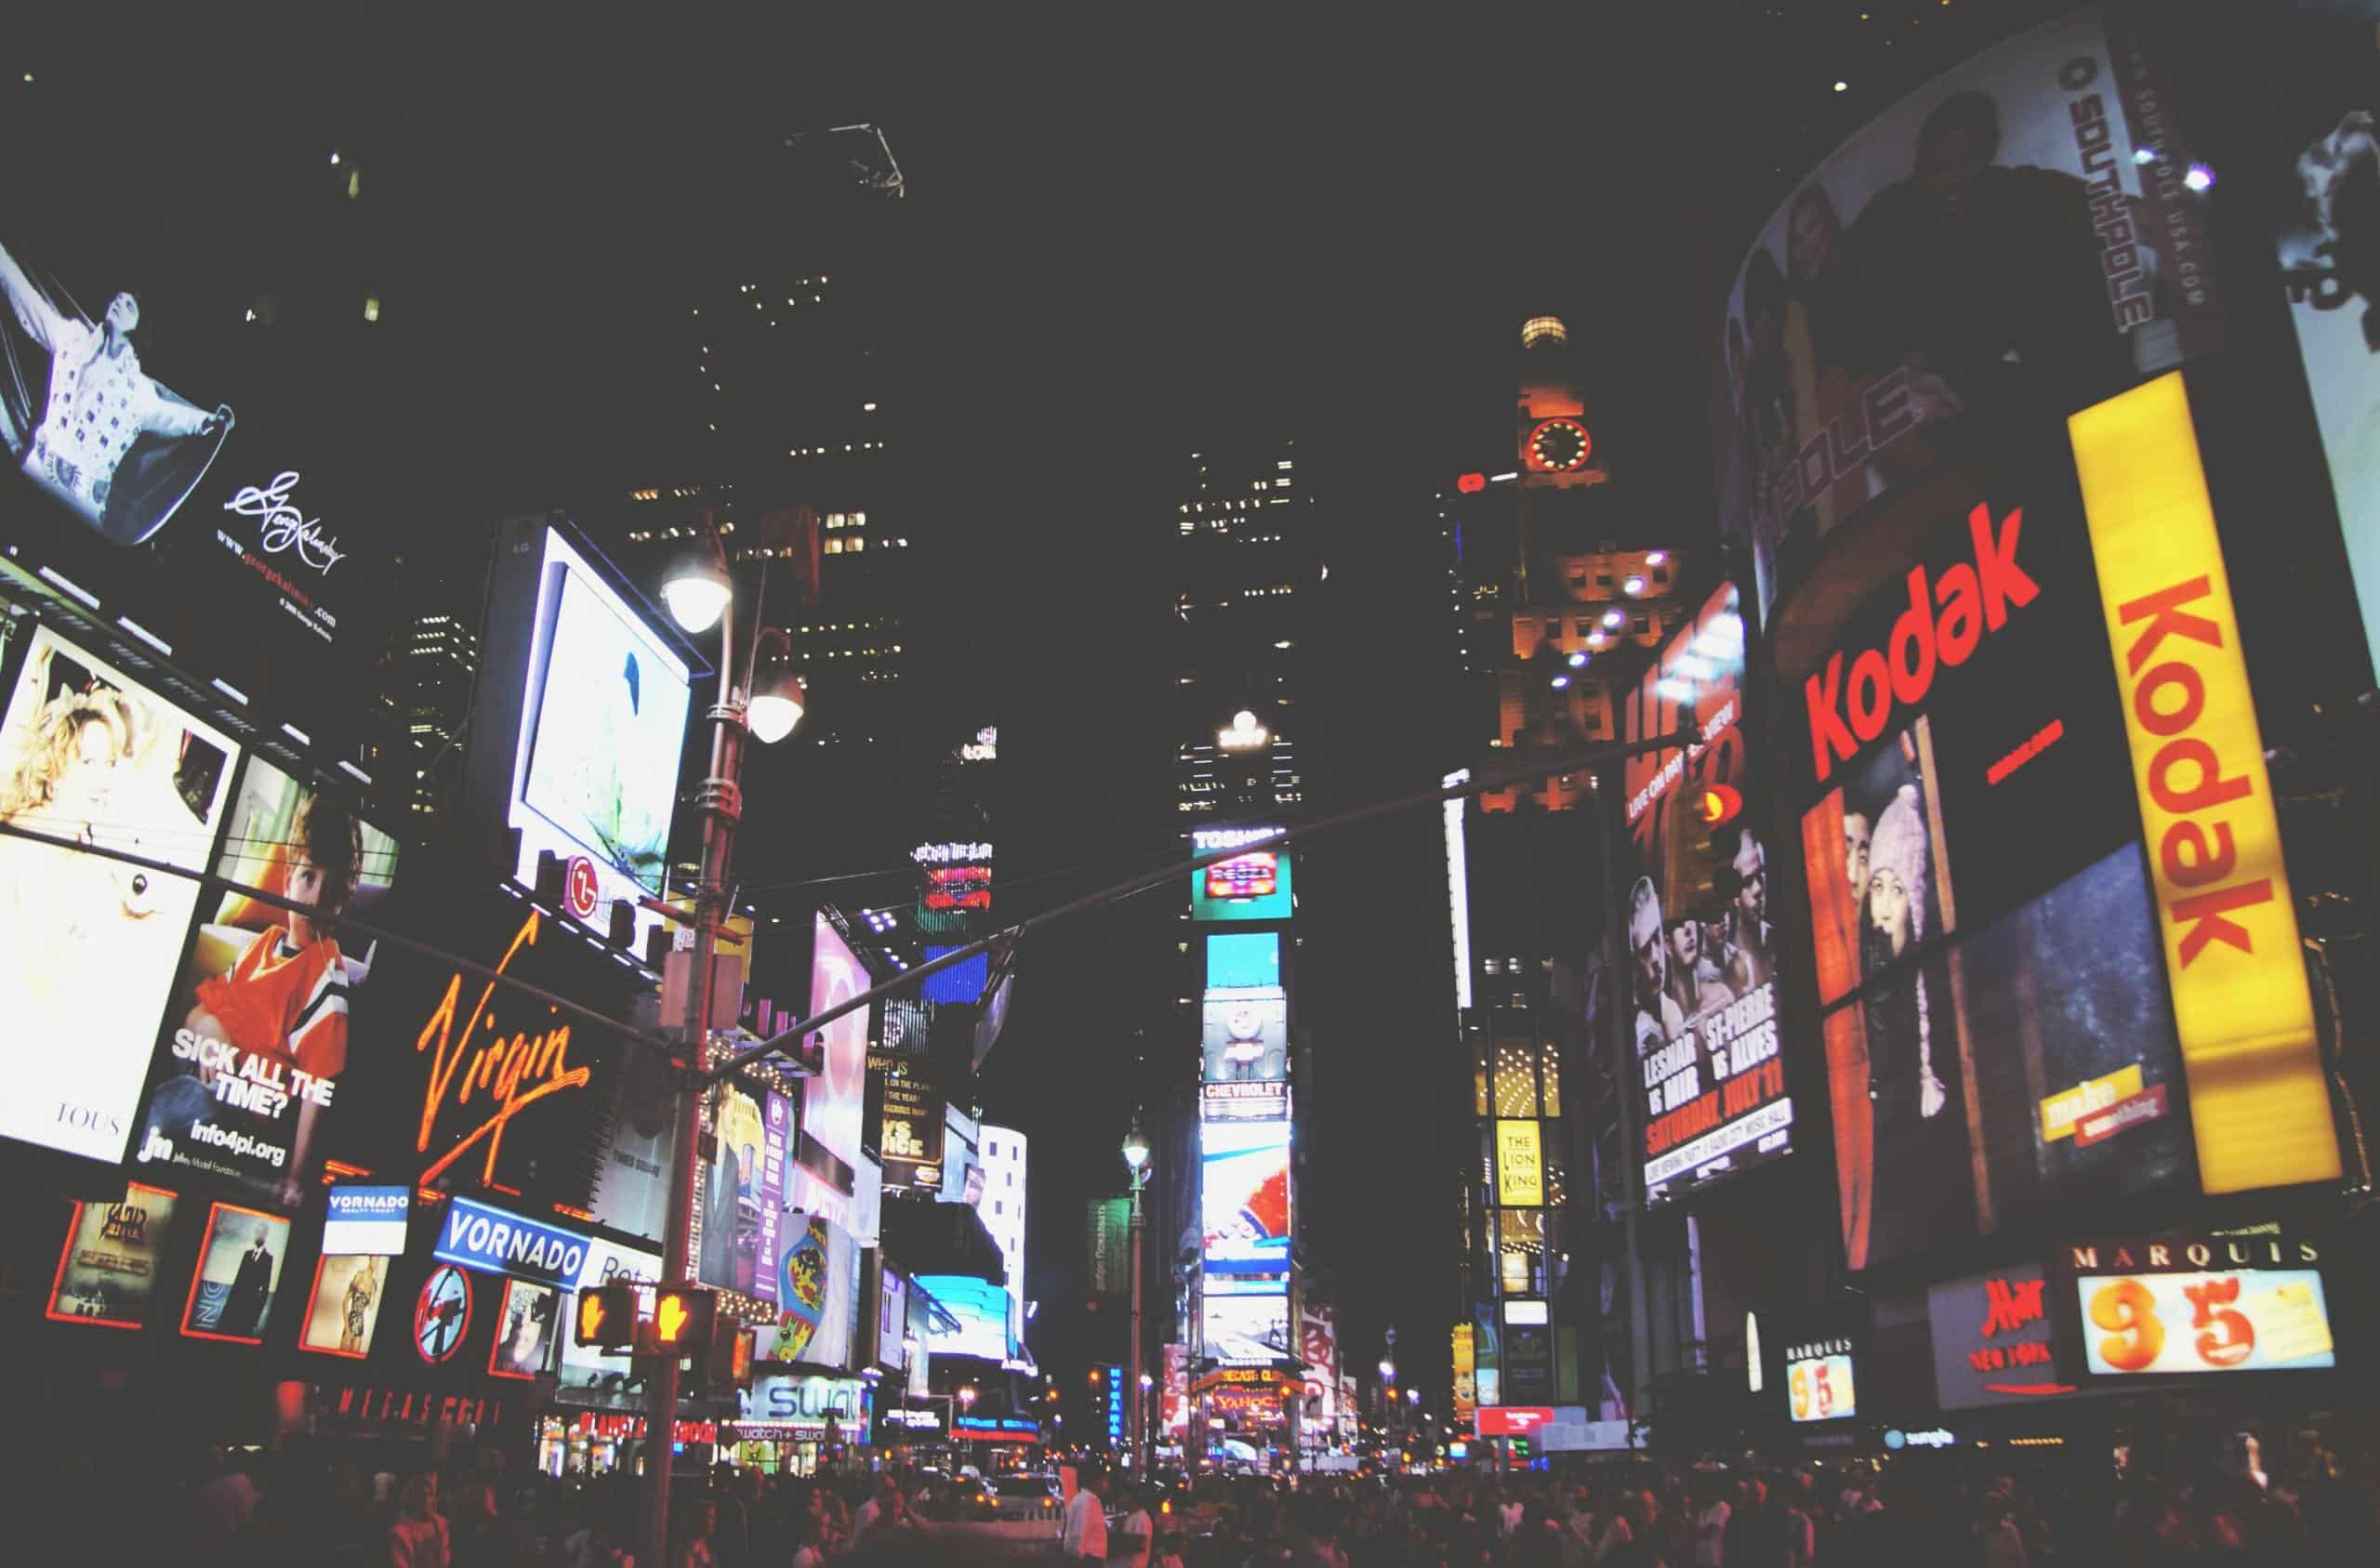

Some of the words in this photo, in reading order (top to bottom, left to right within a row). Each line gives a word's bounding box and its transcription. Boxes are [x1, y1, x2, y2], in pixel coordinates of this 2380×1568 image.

[2068, 91, 2154, 333] SOUTHPOLE
[1805, 502, 2042, 783] Kodak
[2118, 574, 2275, 970] Kodak
[171, 1028, 241, 1074] SICK
[238, 1053, 286, 1092] ALL
[289, 1068, 337, 1108] THE
[416, 907, 592, 1190] Virgin
[216, 1072, 288, 1119] TIME?
[1205, 1080, 1284, 1100] CHEVROLET
[1724, 1070, 1761, 1119] JULY
[190, 1118, 286, 1167] info4pi.org
[1502, 1152, 1537, 1171] LION
[1507, 1136, 1532, 1148] THE
[329, 1194, 409, 1208] VORNADO
[1503, 1174, 1538, 1194] KING
[449, 1209, 579, 1277] VORNADO
[2069, 1242, 2319, 1269] MARQUIS
[1786, 1338, 1853, 1361] MARQUIS
